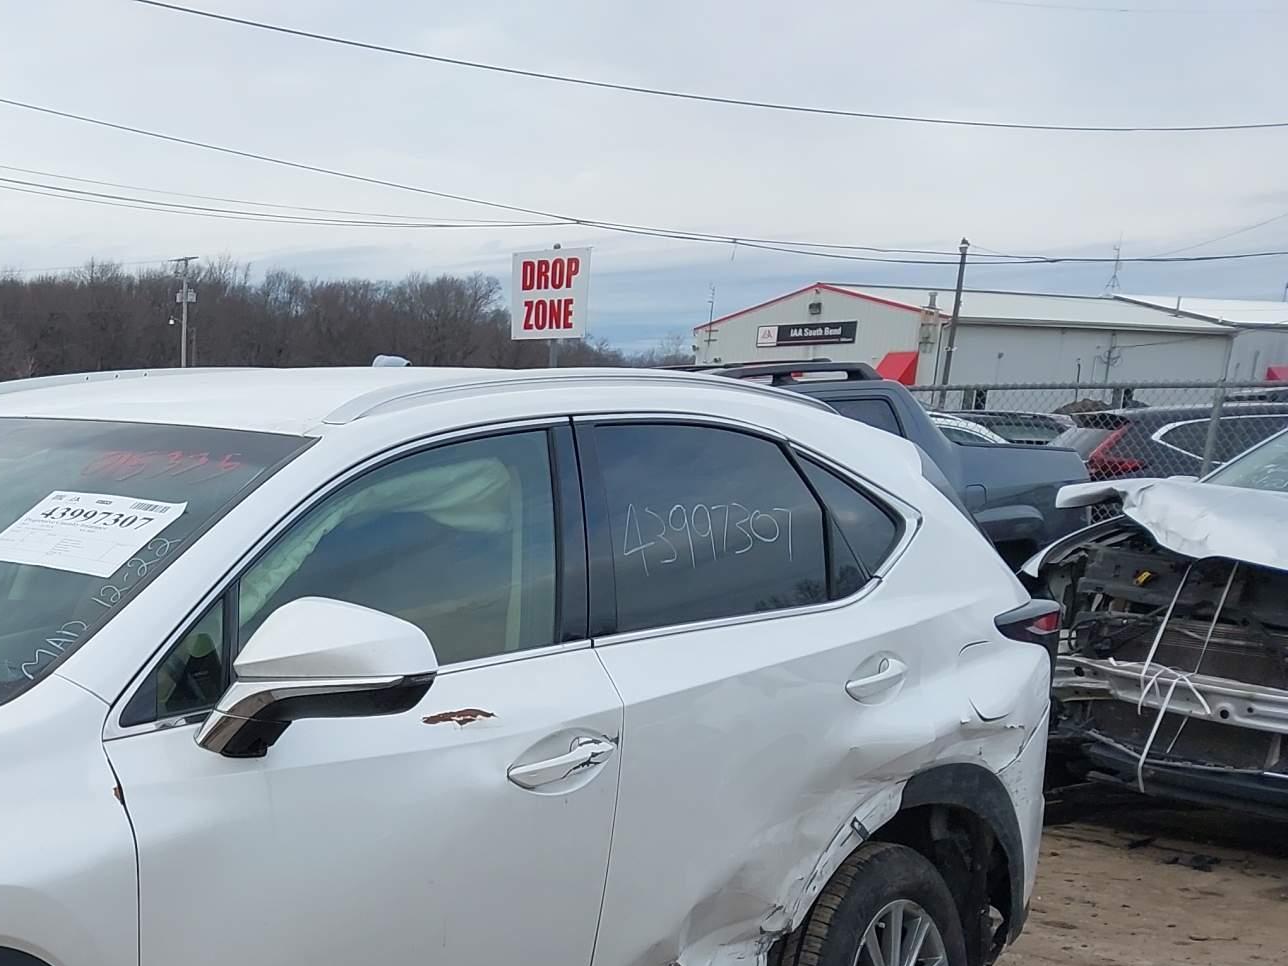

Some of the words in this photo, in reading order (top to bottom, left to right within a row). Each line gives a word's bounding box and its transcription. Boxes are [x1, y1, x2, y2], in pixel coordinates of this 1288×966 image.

[522, 257, 580, 291] DROP
[523, 298, 574, 330] ZONE
[803, 327, 824, 337] South
[40, 506, 155, 531] 43997307
[624, 502, 793, 577] 43997307
[91, 537, 182, 608] 12-22
